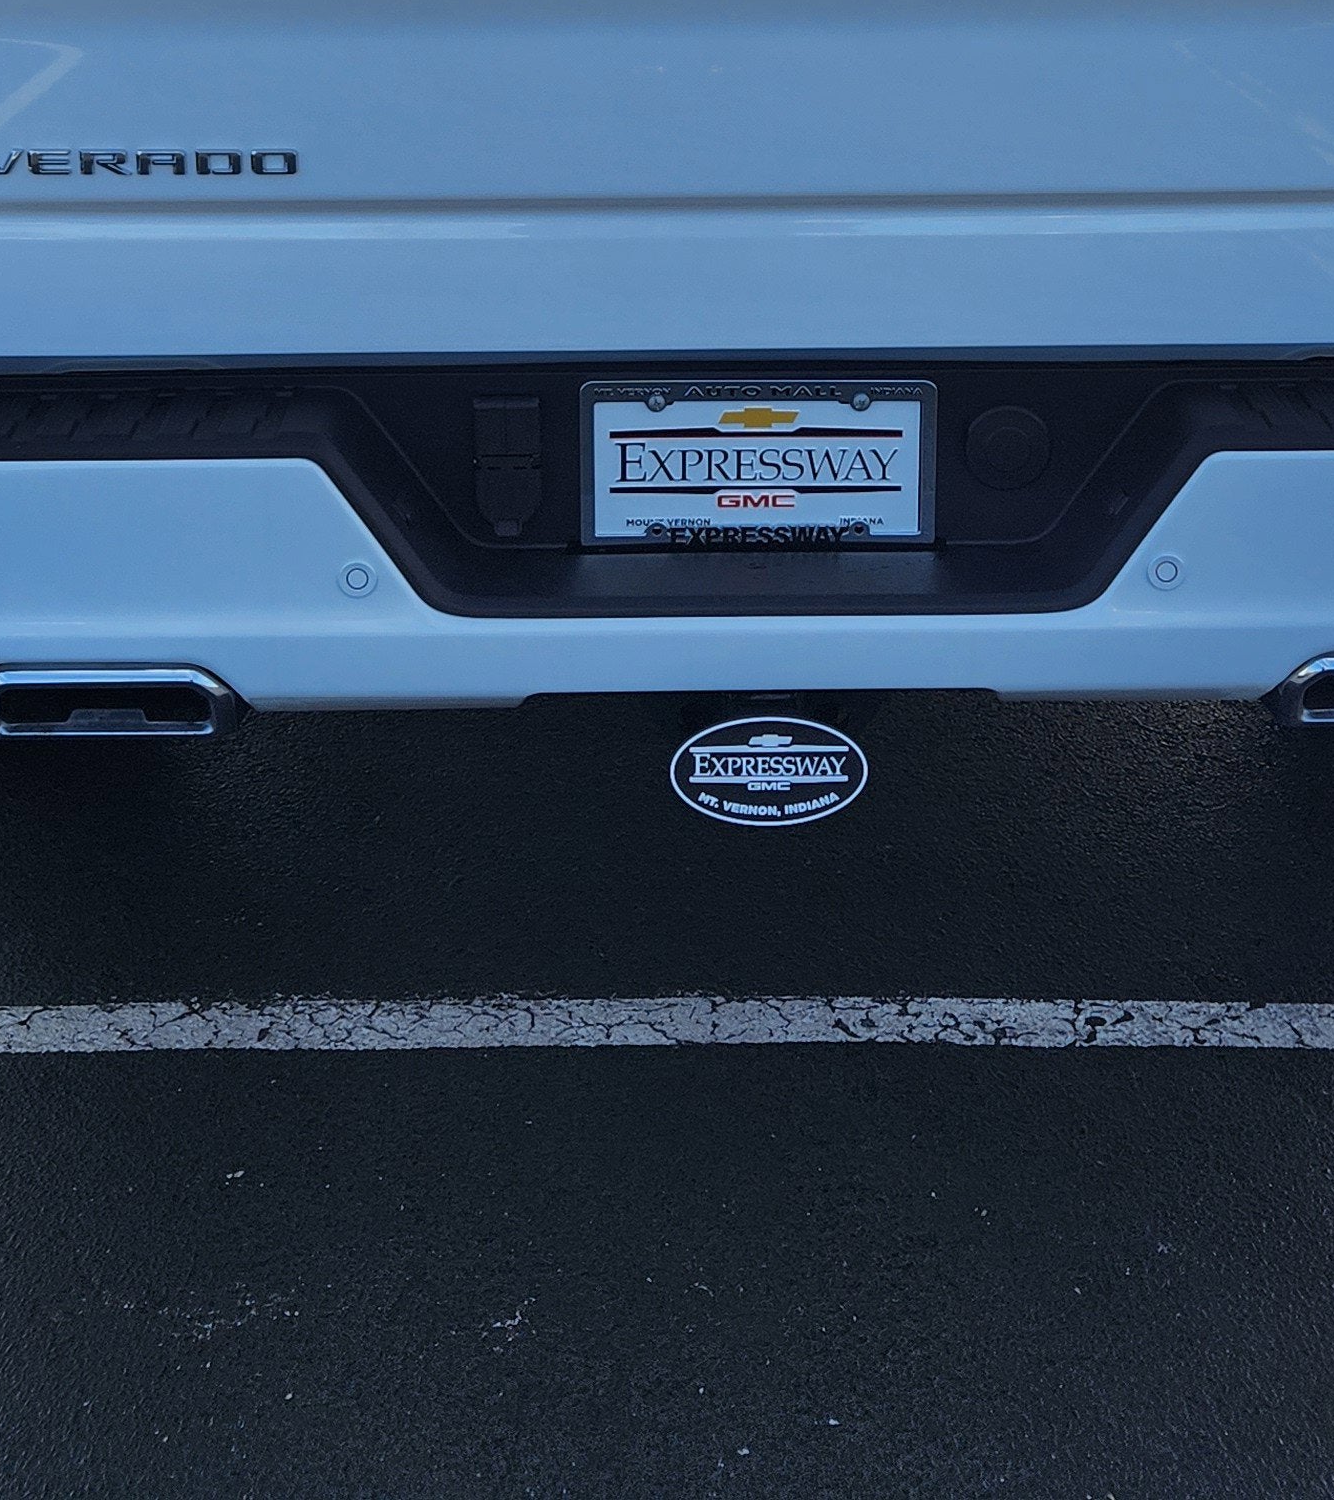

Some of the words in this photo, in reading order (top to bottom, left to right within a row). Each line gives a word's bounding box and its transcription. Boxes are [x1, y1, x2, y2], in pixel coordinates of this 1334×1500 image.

[616, 386, 671, 396] VERNON
[684, 385, 762, 398] AUTO
[769, 385, 842, 398] MALL
[870, 386, 923, 396] INDIANA
[717, 494, 795, 508] GMC
[626, 518, 665, 527] MOU
[667, 518, 711, 527] VERNON
[670, 525, 850, 545] EXPRESSWAY
[747, 781, 791, 791] GMC
[698, 792, 719, 808] MT.
[723, 800, 782, 817] VERNON,
[784, 792, 840, 815] INDIANA
